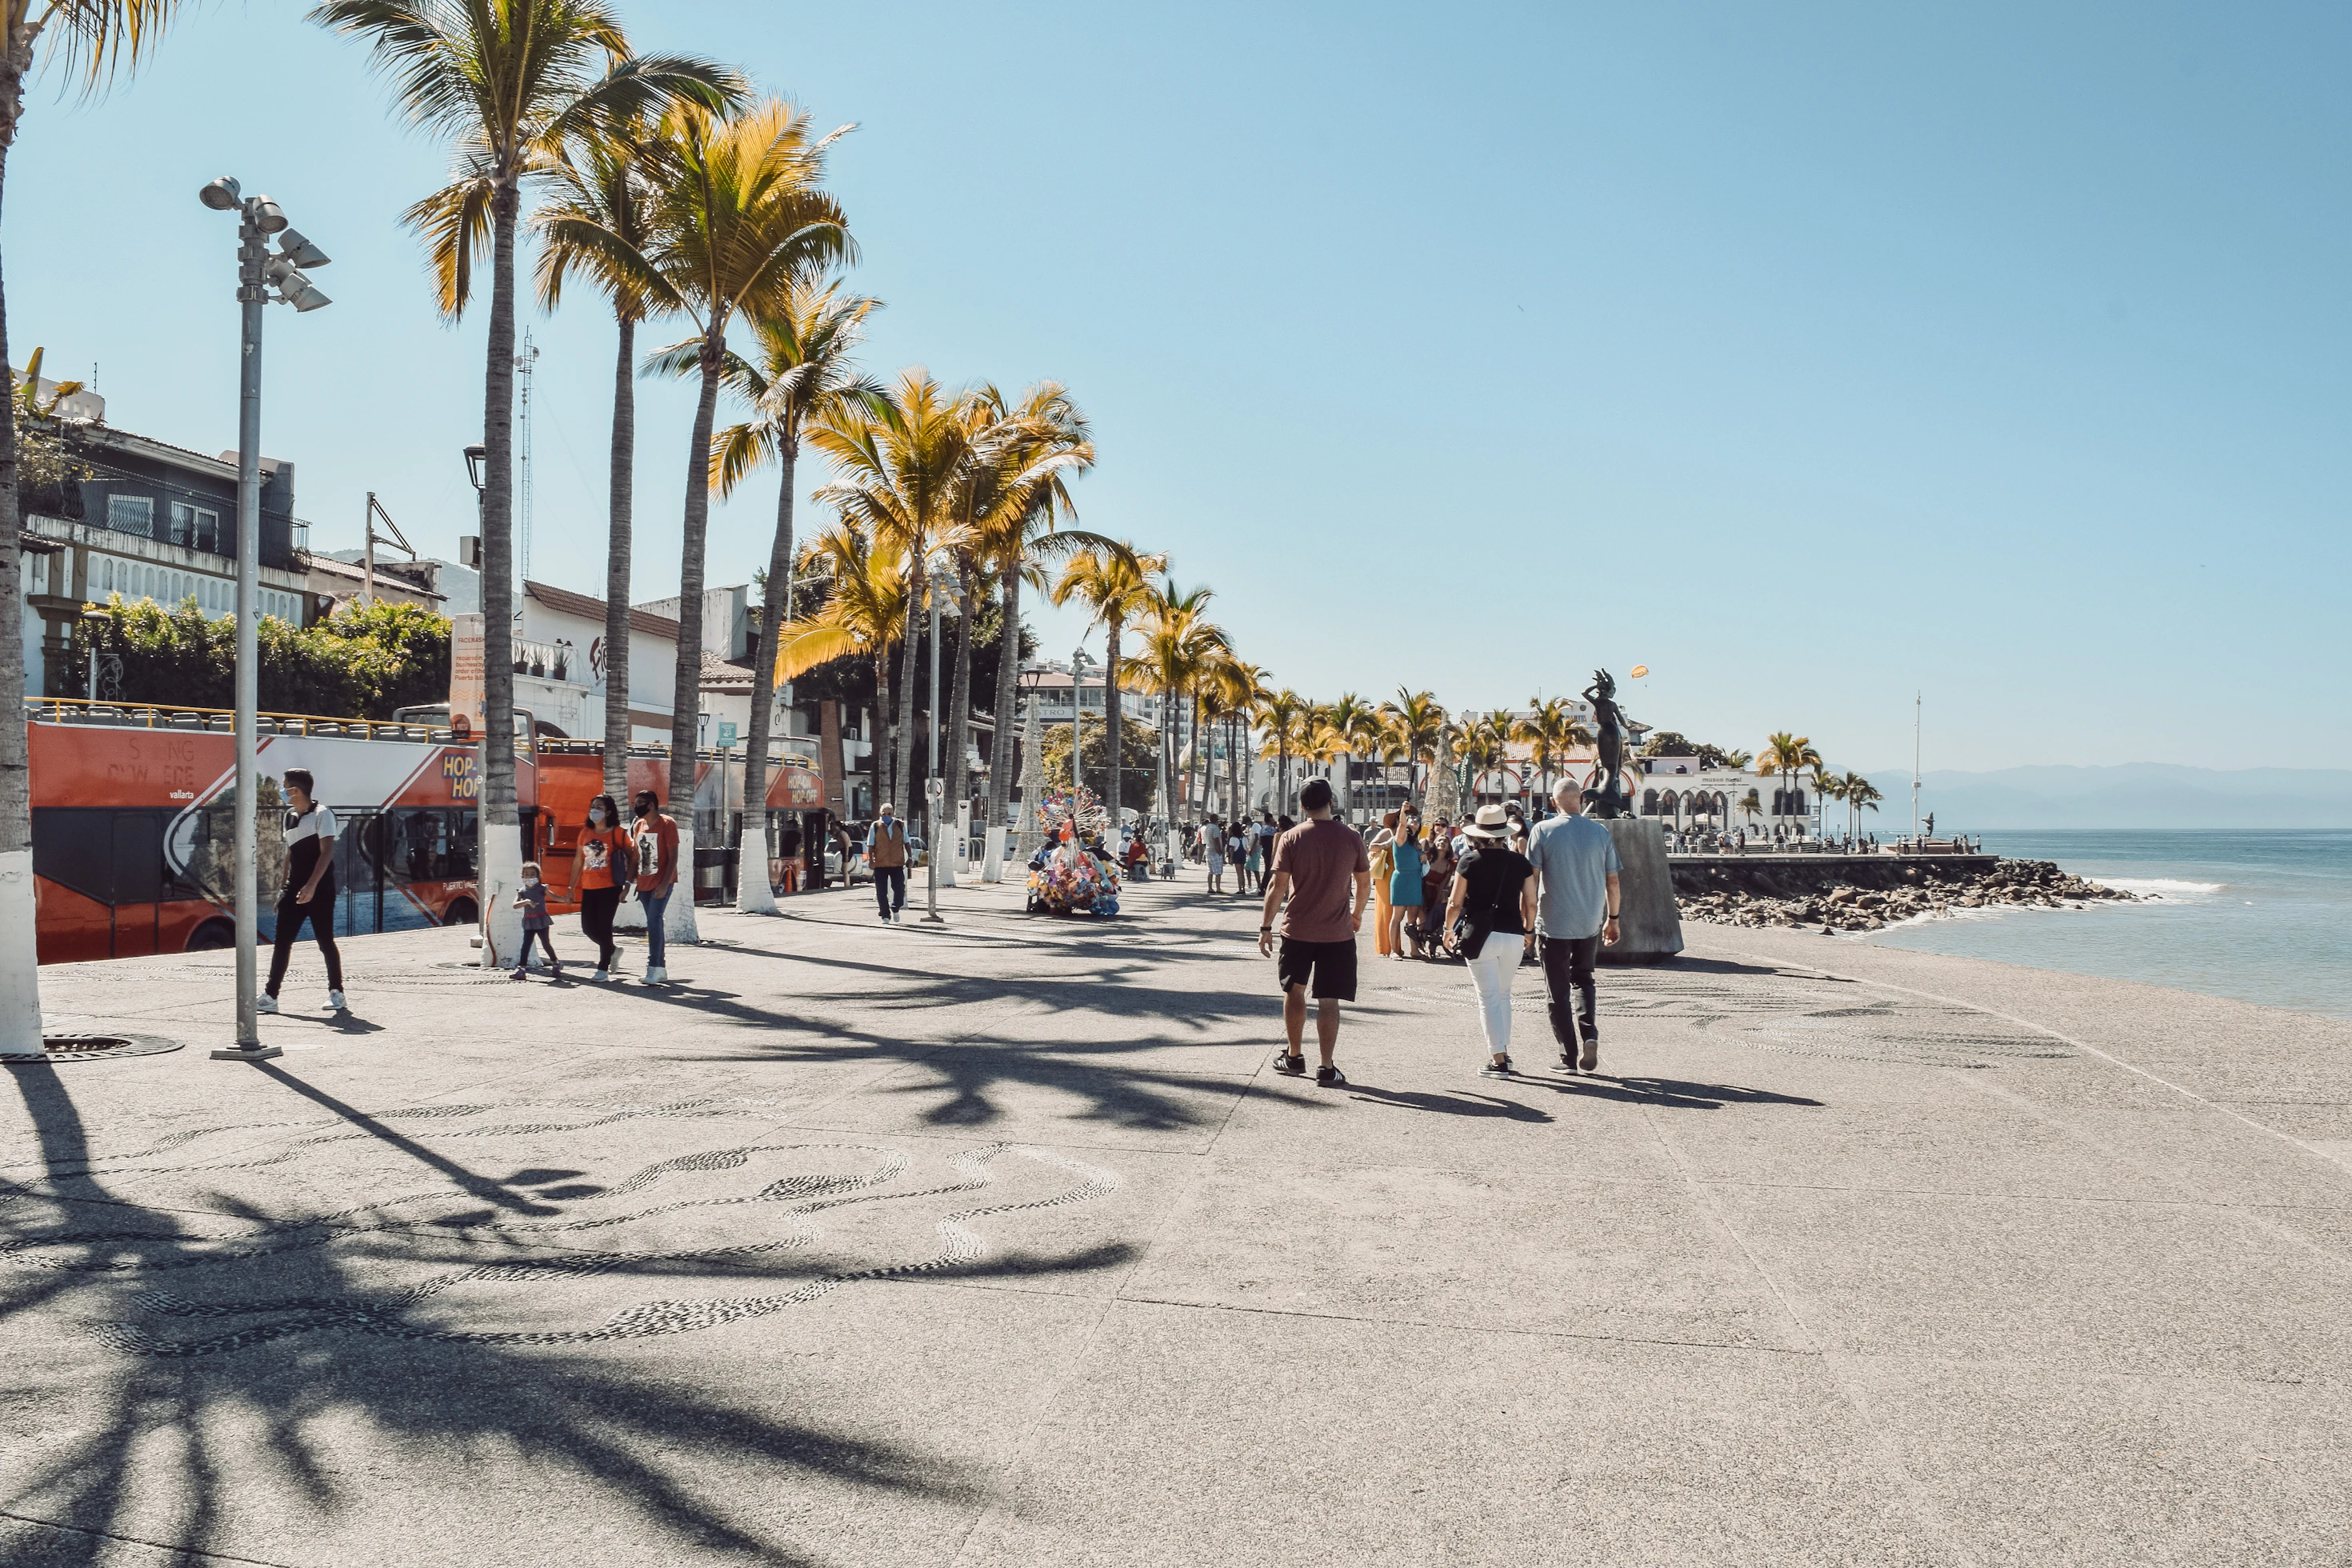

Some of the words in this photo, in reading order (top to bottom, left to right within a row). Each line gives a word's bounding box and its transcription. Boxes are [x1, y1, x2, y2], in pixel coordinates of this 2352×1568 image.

[788, 775, 811, 789] HOP-ON
[170, 789, 194, 799] vallarta
[792, 790, 817, 803] HOP-OFF
